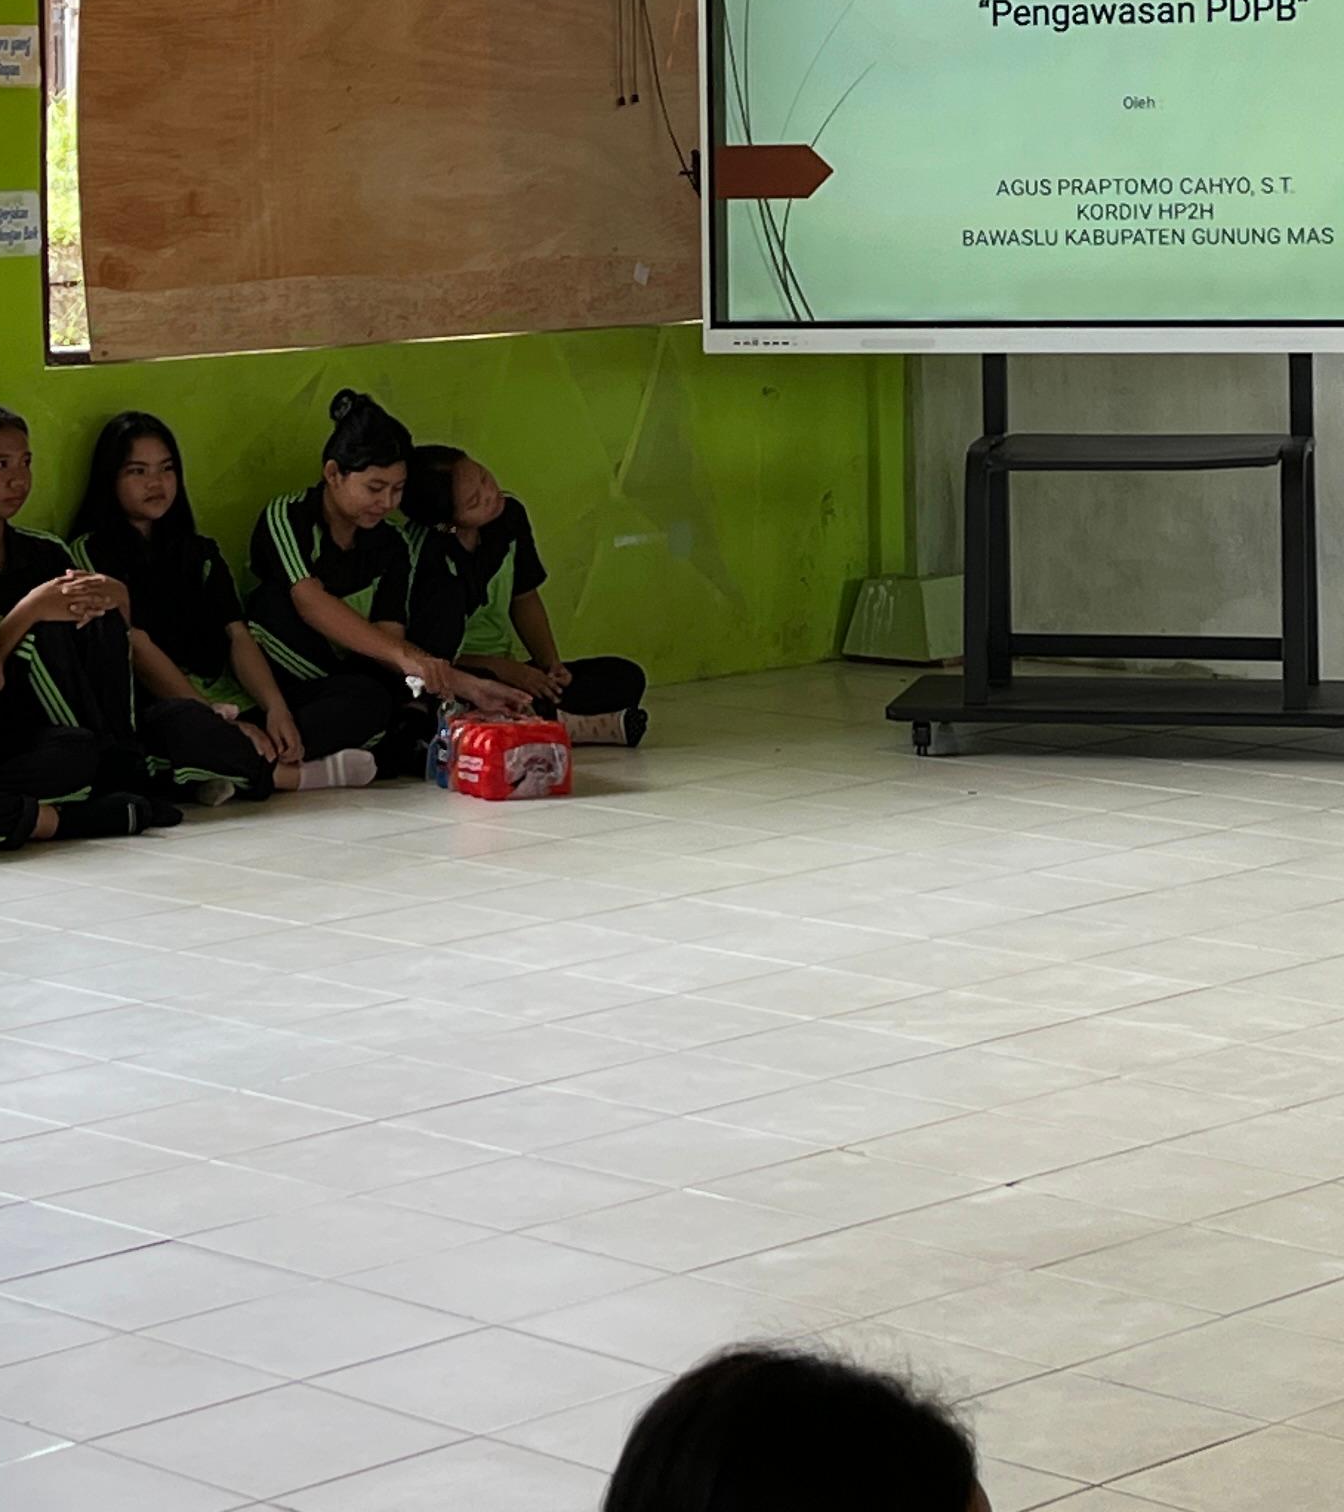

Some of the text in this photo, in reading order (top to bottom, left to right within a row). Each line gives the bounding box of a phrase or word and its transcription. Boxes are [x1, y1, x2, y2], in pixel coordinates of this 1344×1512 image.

[1123, 96, 1155, 110] Oleh
[996, 178, 1052, 196] AGUS
[1058, 177, 1173, 195] PRAPTOMO
[1180, 176, 1255, 197] CAHYO,
[1077, 203, 1214, 220] KORDIV HP2H
[963, 226, 1334, 246] BAWASLU KABUPATEN GUNUNG MAS
